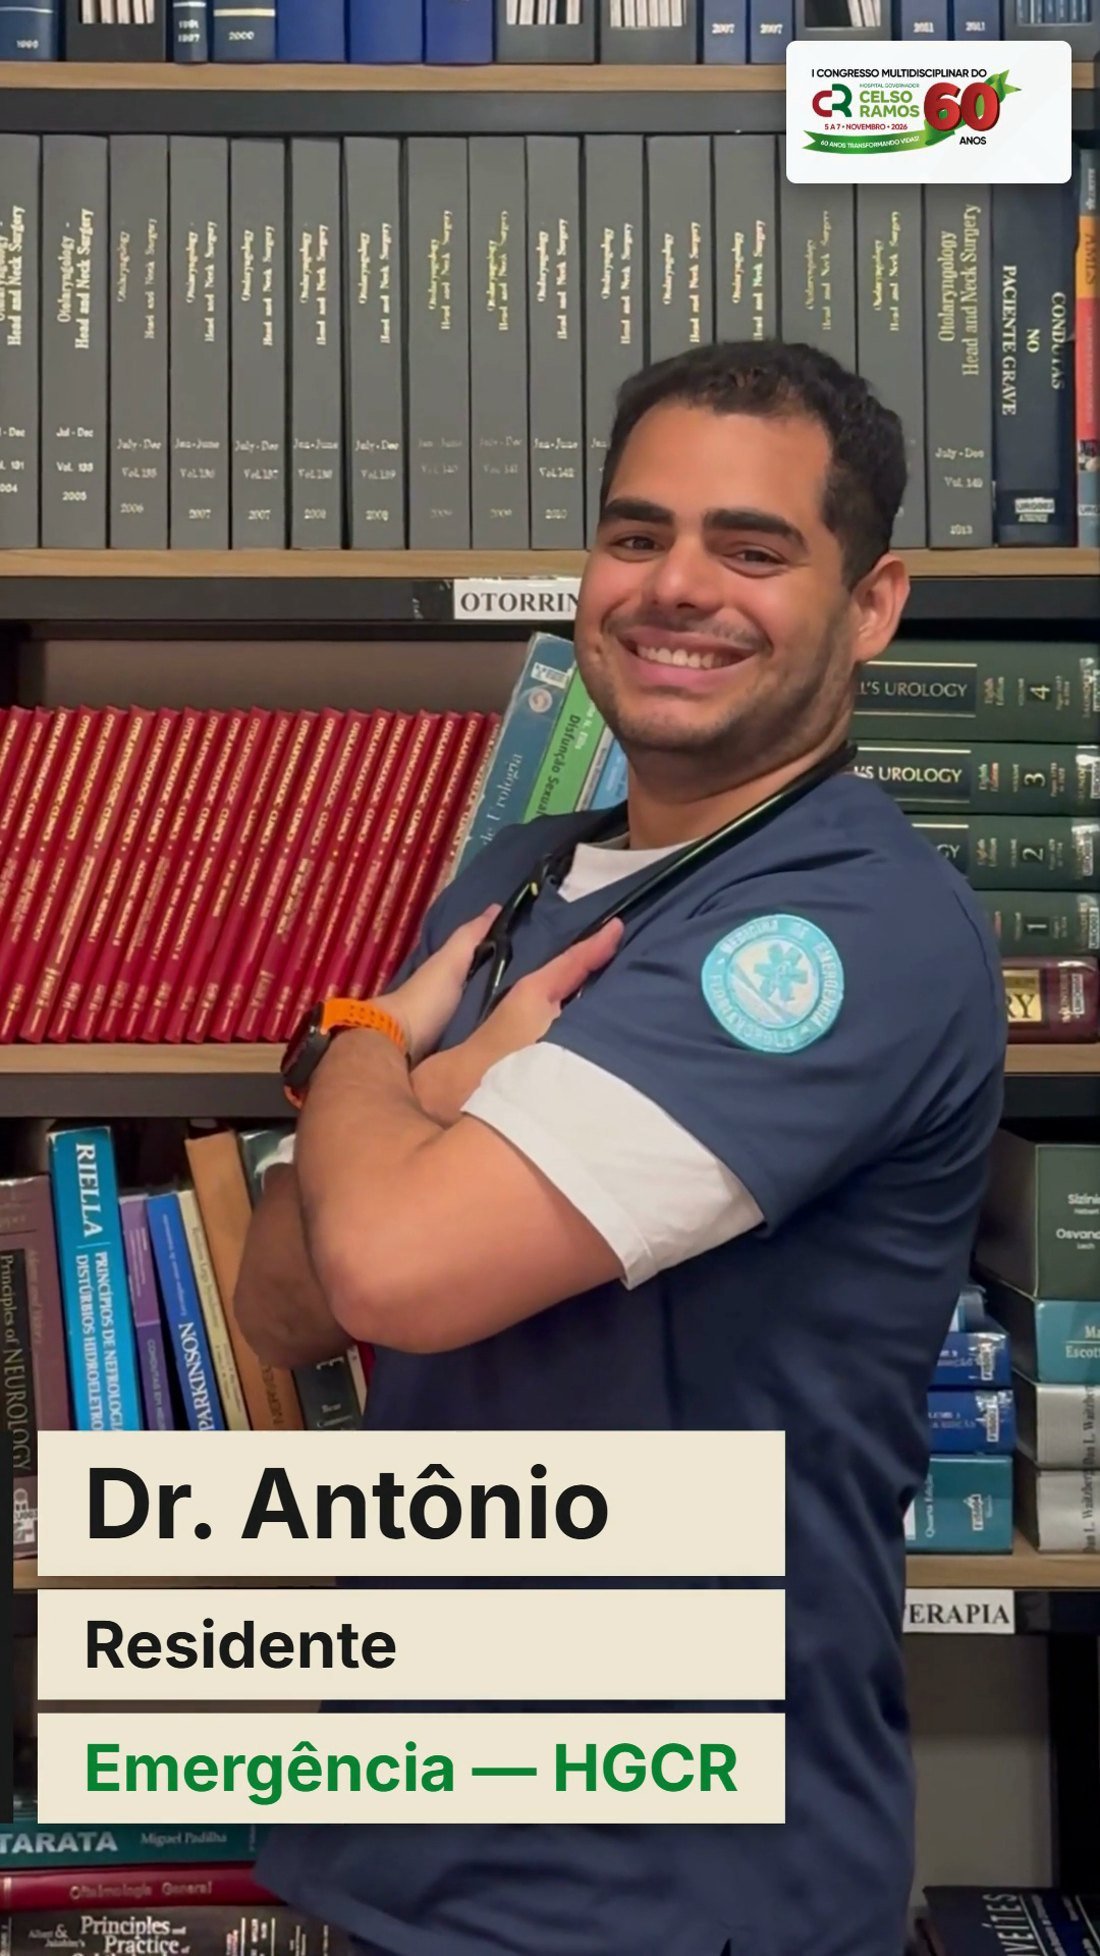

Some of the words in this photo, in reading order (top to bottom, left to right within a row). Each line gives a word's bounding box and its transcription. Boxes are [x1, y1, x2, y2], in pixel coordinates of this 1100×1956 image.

[228, 31, 255, 40] 2000
[712, 23, 734, 34] 2007
[7, 206, 25, 251] Surgery
[77, 209, 93, 255] Surgery
[963, 206, 981, 262] Surgery
[6, 256, 22, 285] Neck
[57, 236, 75, 322] Otolaryngology
[76, 259, 90, 289] Neck
[961, 266, 977, 302] Neck
[8, 290, 21, 311] and
[937, 231, 958, 341] Otolaryngology
[76, 293, 89, 314] and
[1003, 266, 1016, 352] PACIENTE
[7, 316, 21, 345] Head
[75, 319, 89, 348] Head
[963, 306, 977, 333] and
[1027, 329, 1039, 352] NO
[962, 343, 978, 375] Head
[1002, 356, 1016, 415] GRAVE
[77, 427, 93, 437] Dec
[885, 682, 967, 697] UROLOGY
[1029, 684, 1051, 700] 4
[550, 714, 581, 778] Disfunção
[878, 766, 963, 783] UROLOGY
[1024, 772, 1046, 788] 3
[18, 803, 36, 839] CLINICS
[42, 805, 60, 841] CLINICS
[67, 804, 84, 840] CLINICS
[123, 807, 139, 843] CLINICS
[148, 807, 165, 842] CLINICS
[1022, 847, 1044, 862] 2
[1026, 923, 1048, 932] 1
[75, 1143, 104, 1237] RIELLA
[76, 1255, 97, 1335] DISTÚRBIOS
[95, 1251, 115, 1327] PRINCÍPIOS
[102, 1329, 115, 1347] DE
[178, 1322, 216, 1431] PARKINSON
[905, 1603, 1010, 1625] ERAPIA
[0, 1831, 118, 1854] TARATA
[140, 1831, 182, 1847] Miguel
[184, 1829, 227, 1844] Padilha
[162, 1881, 213, 1896] General
[55, 1924, 68, 1939] &
[80, 1916, 171, 1936] Principles
[104, 1935, 180, 1955] Practice
